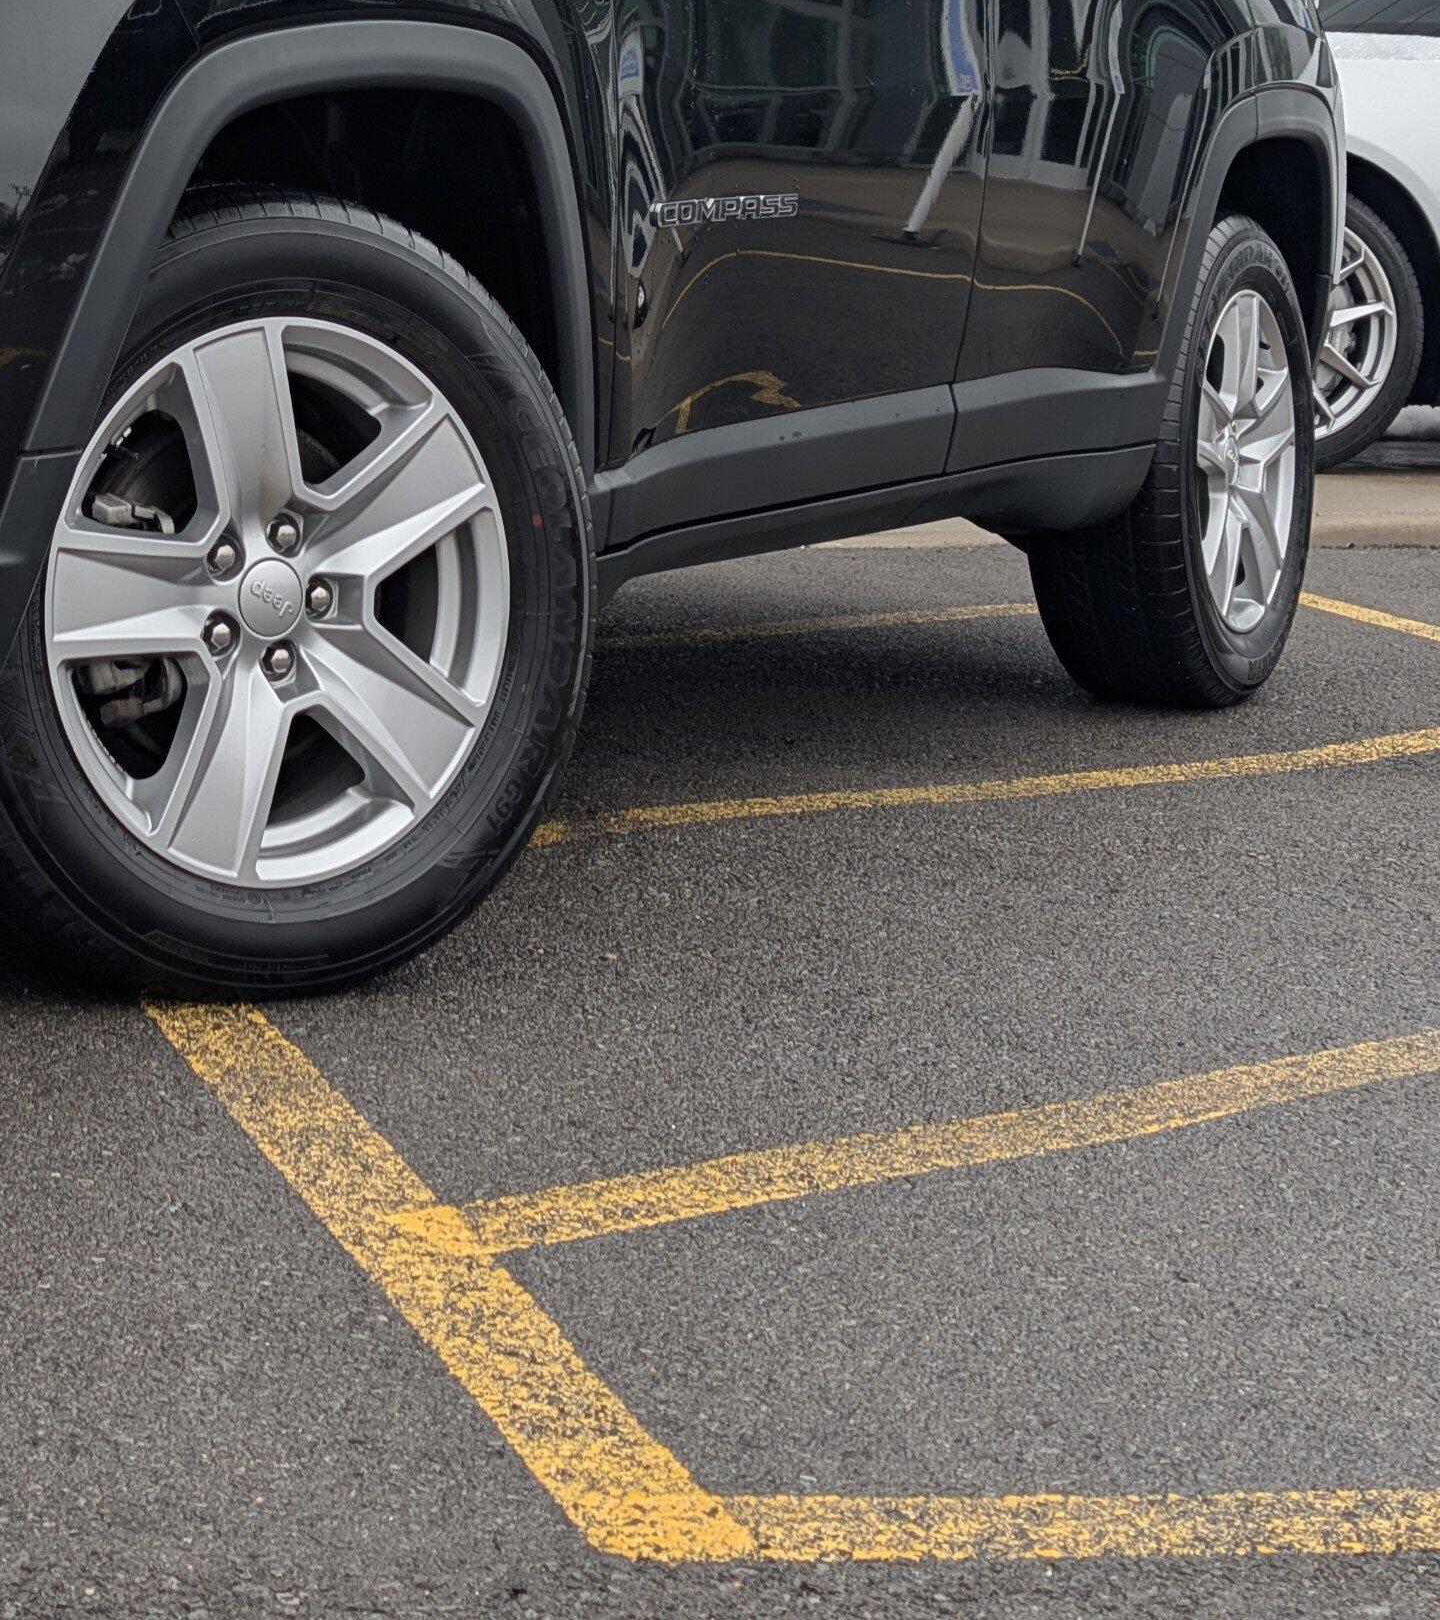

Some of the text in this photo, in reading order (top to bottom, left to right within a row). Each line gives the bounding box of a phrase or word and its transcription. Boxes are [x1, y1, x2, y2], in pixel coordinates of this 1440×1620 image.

[650, 194, 799, 228] COMPASS
[250, 579, 293, 619] Jeep
[485, 776, 527, 836] G91
